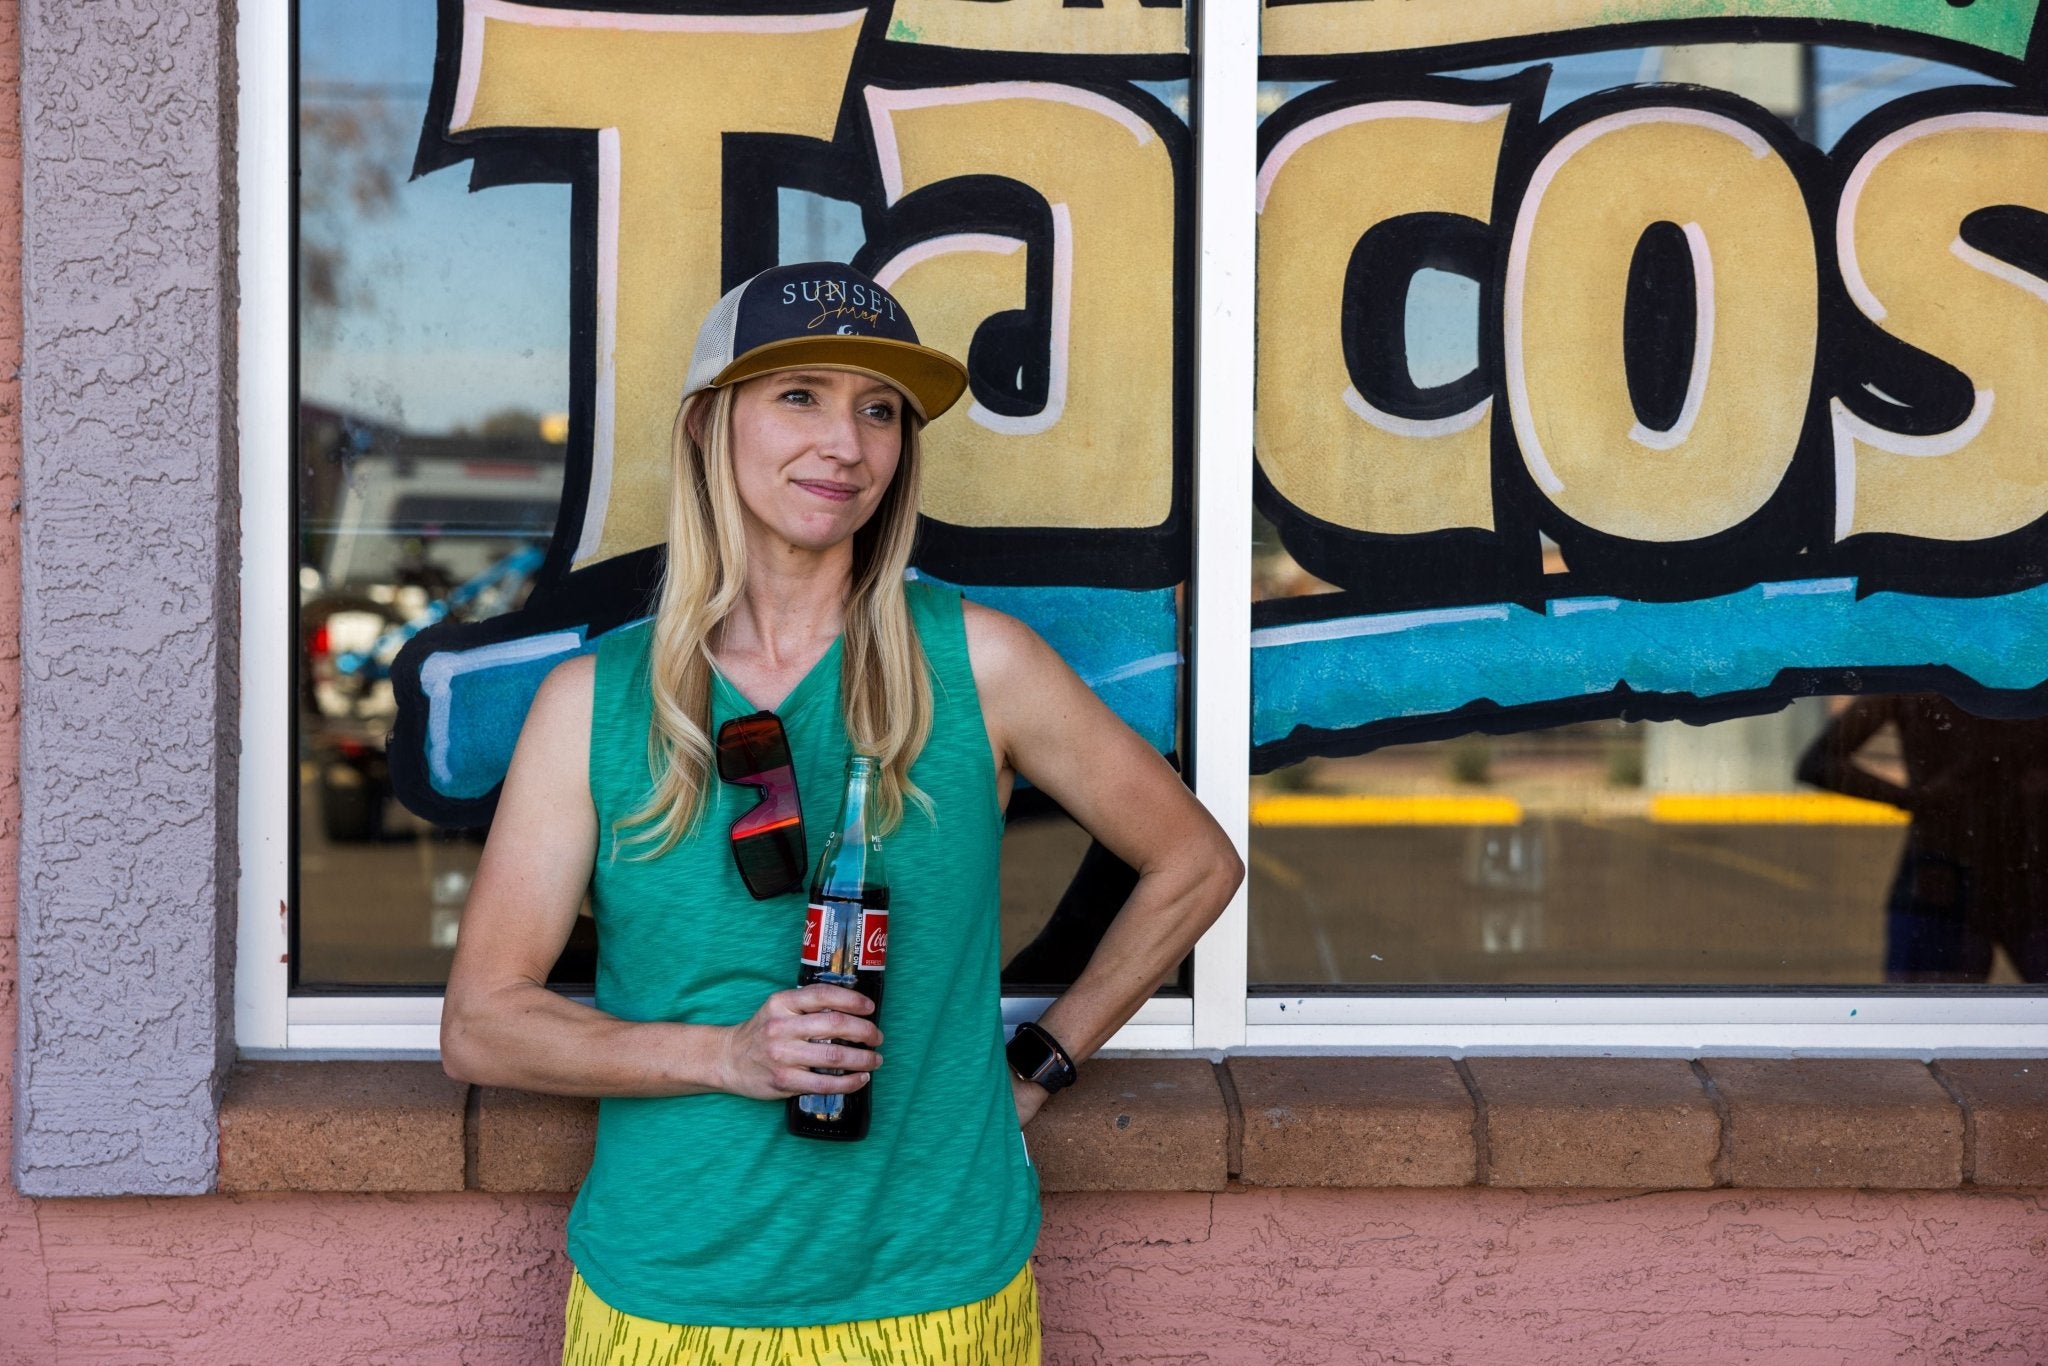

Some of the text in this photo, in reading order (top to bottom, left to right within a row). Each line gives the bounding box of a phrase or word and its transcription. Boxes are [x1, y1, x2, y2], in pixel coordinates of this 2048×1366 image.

[447, 0, 2048, 573] Tacos
[782, 280, 897, 322] SUNSET
[807, 282, 880, 329] Shred
[853, 913, 863, 965] NO RETORNABLE
